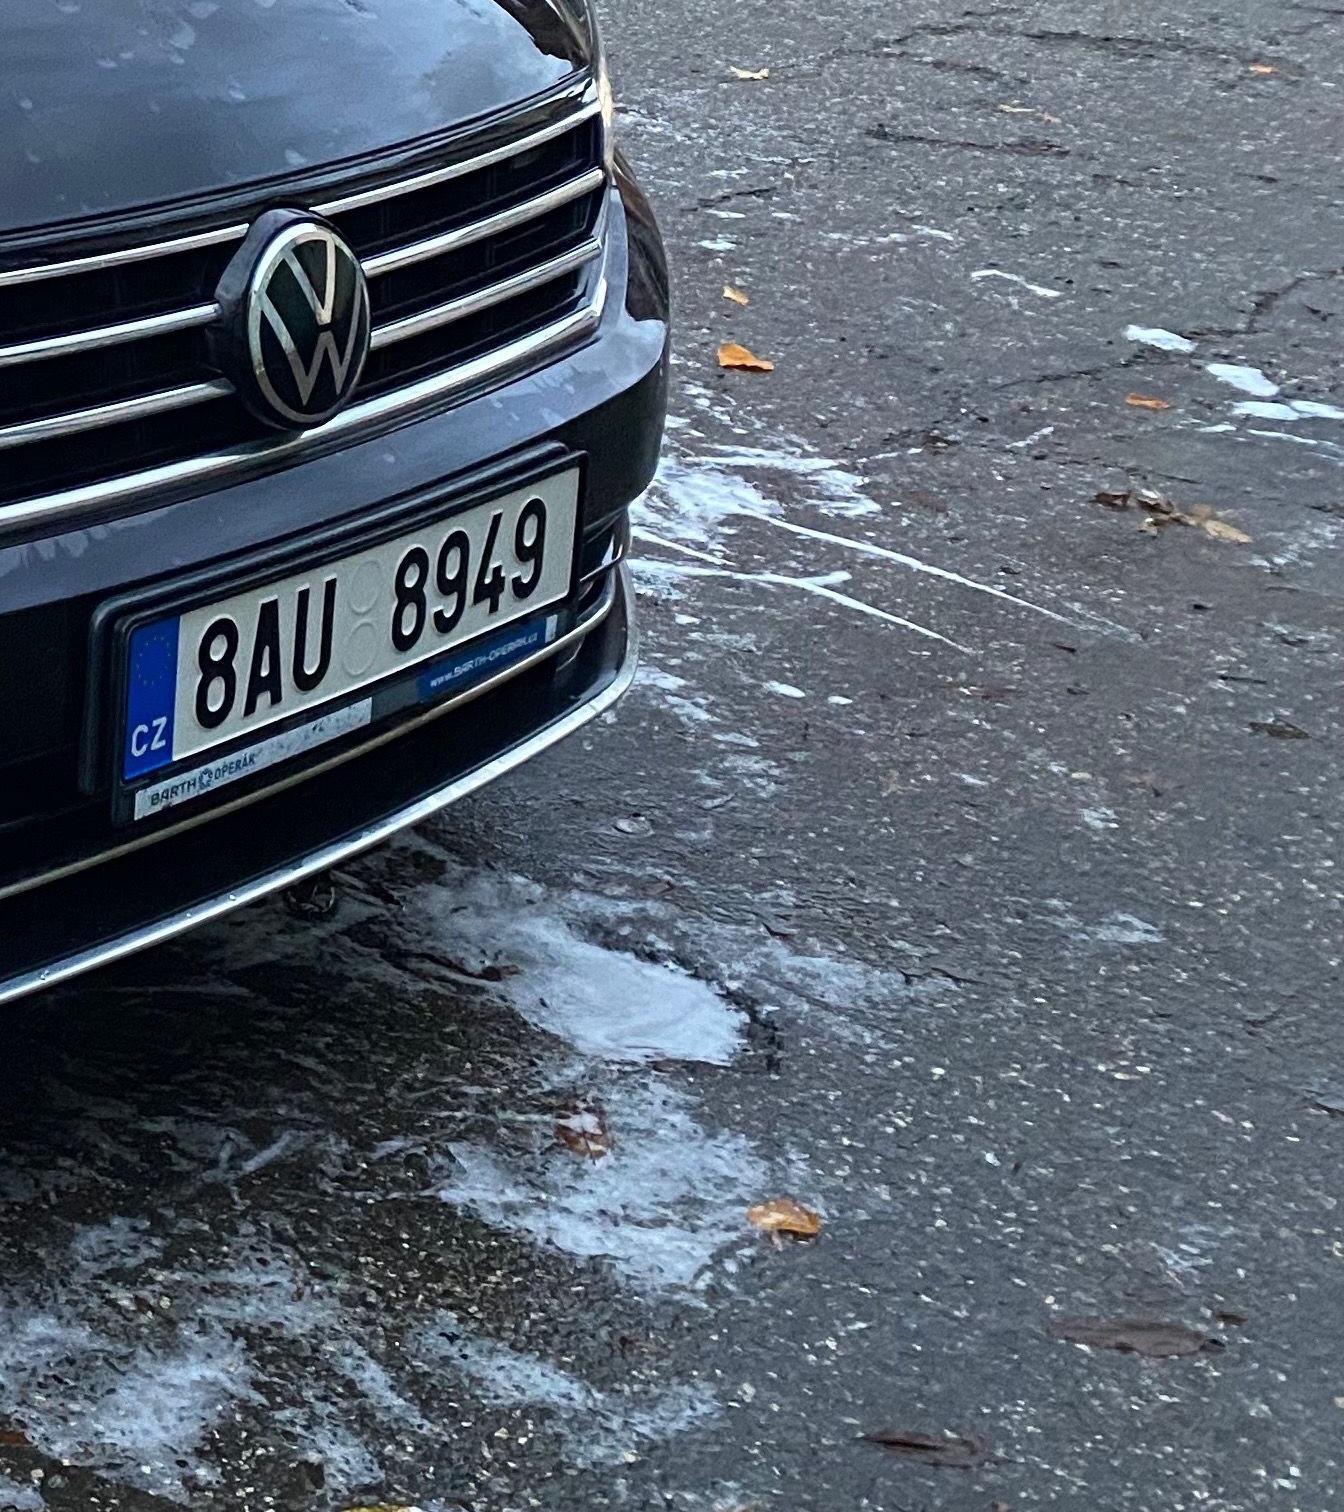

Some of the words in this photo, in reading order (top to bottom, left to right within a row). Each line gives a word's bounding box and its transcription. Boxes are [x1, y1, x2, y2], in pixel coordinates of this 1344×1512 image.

[254, 232, 365, 410] VW
[194, 576, 337, 729] 8AU
[390, 496, 547, 652] 8949
[130, 716, 167, 757] CZ
[150, 779, 197, 806] BARTH
[214, 754, 256, 780] OPERÁK
